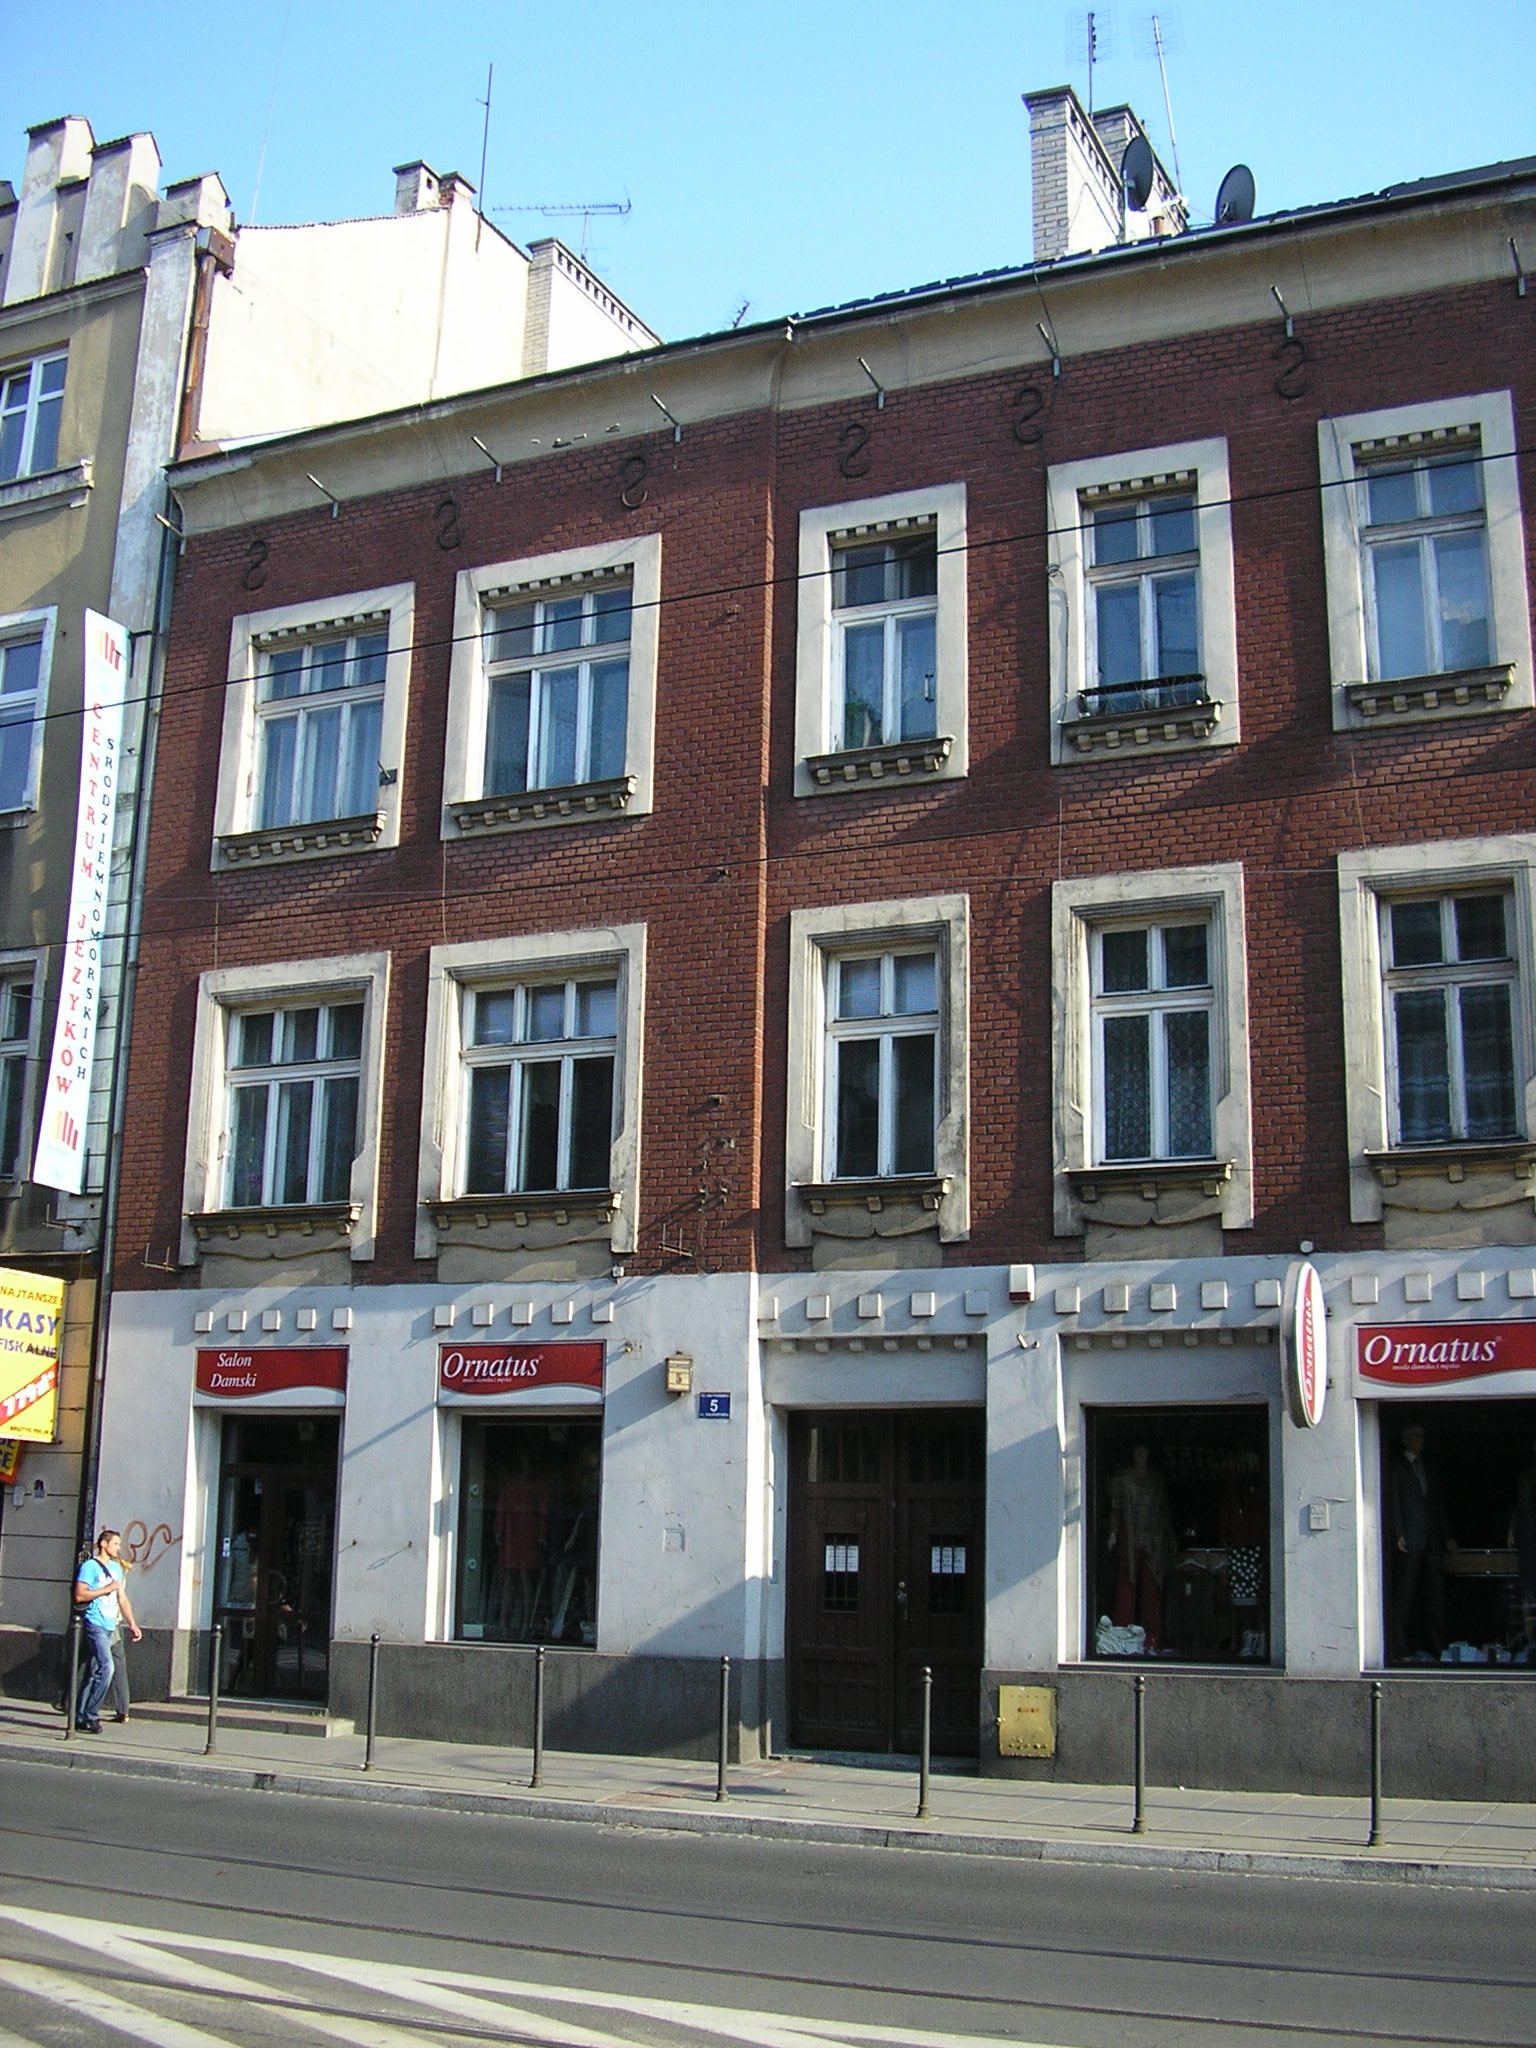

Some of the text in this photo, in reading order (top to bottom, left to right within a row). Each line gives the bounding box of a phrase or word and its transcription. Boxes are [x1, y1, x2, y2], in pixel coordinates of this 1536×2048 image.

[80, 702, 102, 879] CENTRUM
[0, 1307, 61, 1336] KASY
[216, 1352, 252, 1367] Salon
[1364, 1335, 1497, 1366] Ornatus
[443, 1352, 540, 1379] Ornatus
[210, 1373, 257, 1388] Damski
[709, 1399, 719, 1412] 5
